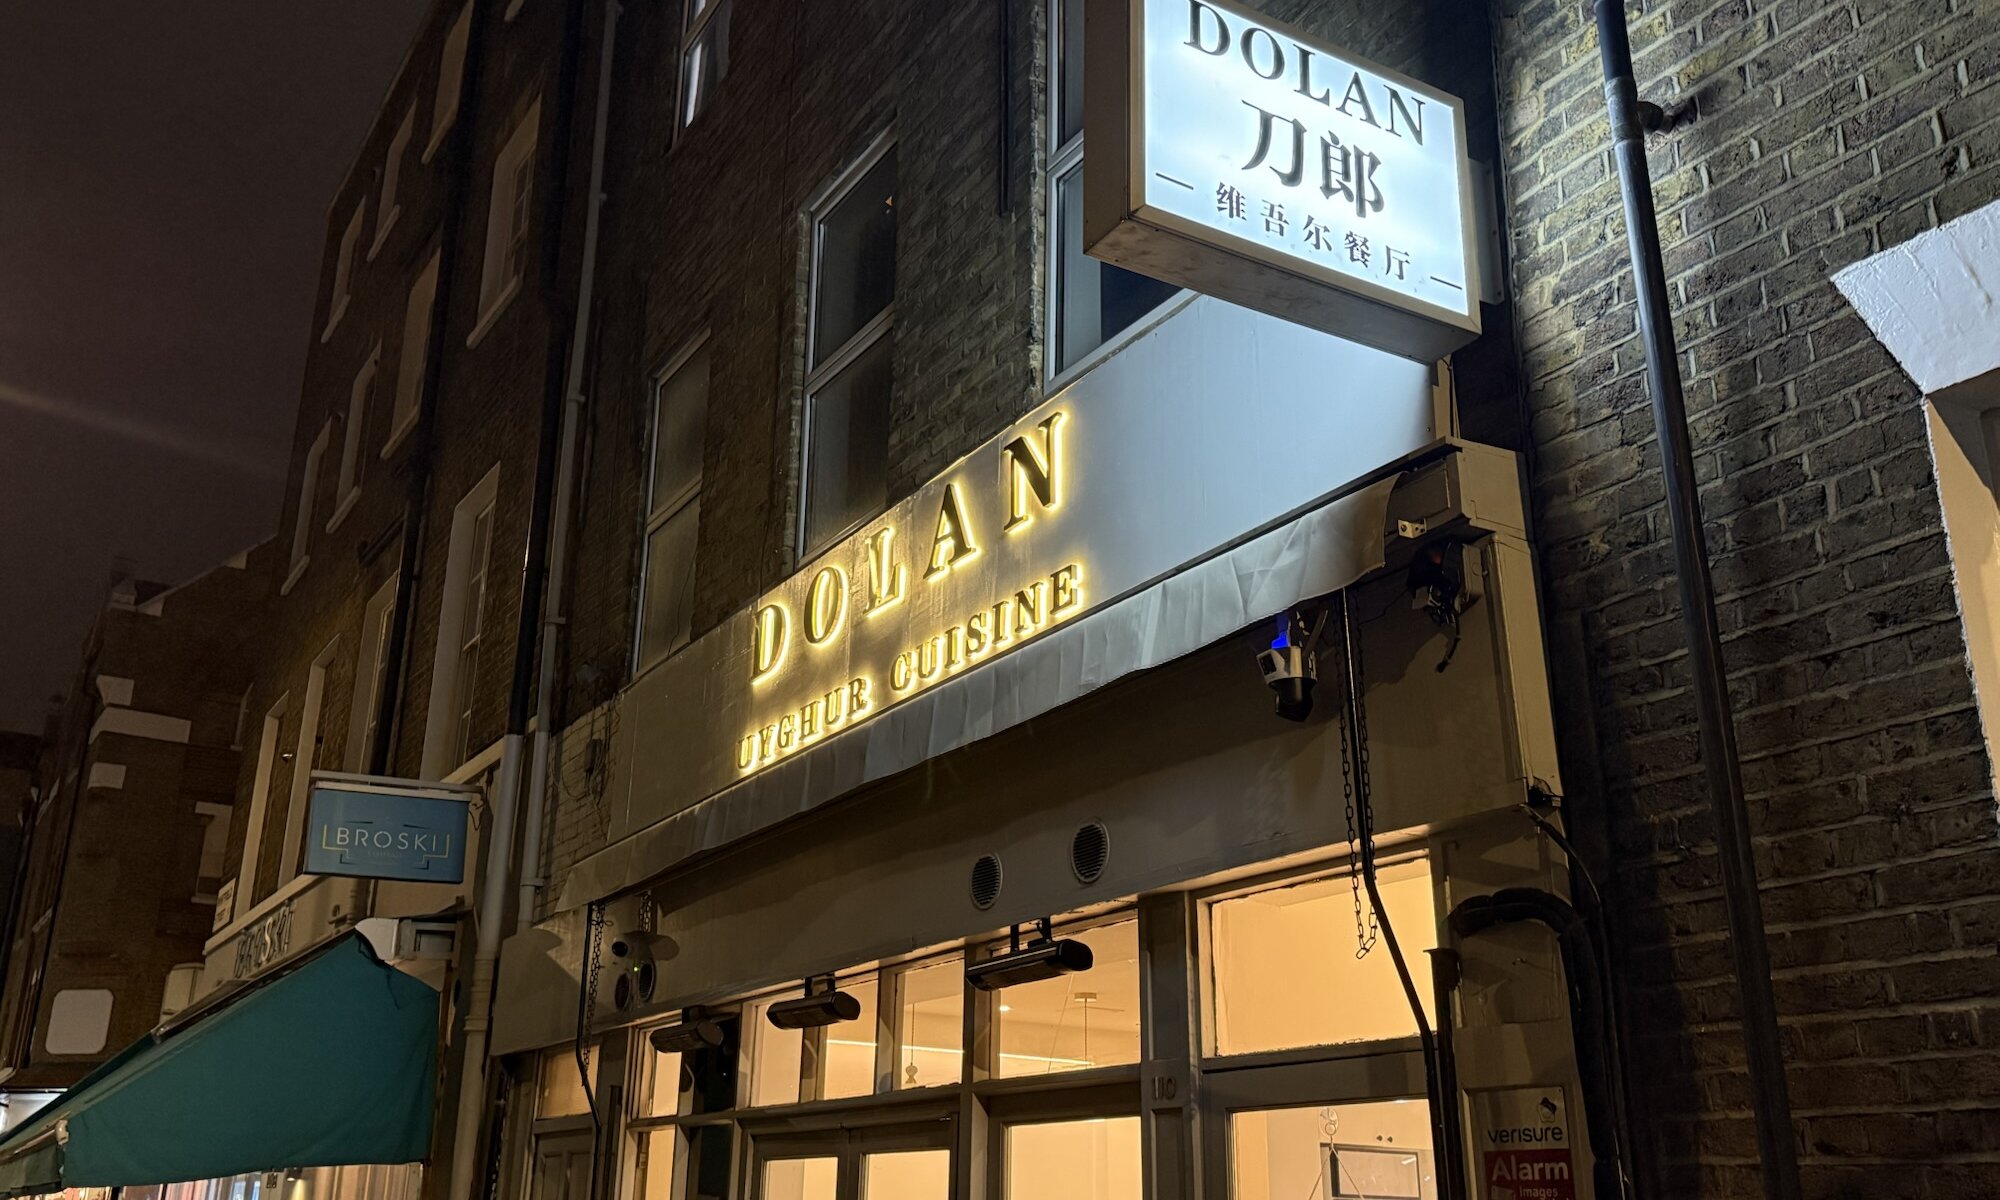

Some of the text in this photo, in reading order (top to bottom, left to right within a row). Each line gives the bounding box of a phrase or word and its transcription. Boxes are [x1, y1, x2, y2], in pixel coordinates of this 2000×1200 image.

[1183, 0, 1426, 146] DOLAN
[1241, 99, 1385, 218] 刀郎
[1216, 182, 1411, 280] 维吾尔餐厅
[750, 411, 1065, 686] DOLAN
[737, 563, 1081, 771] UYGHUR CUISINE
[336, 827, 437, 852] BROSKI
[1487, 1126, 1563, 1144] verisure
[1492, 1154, 1569, 1181] Alarm
